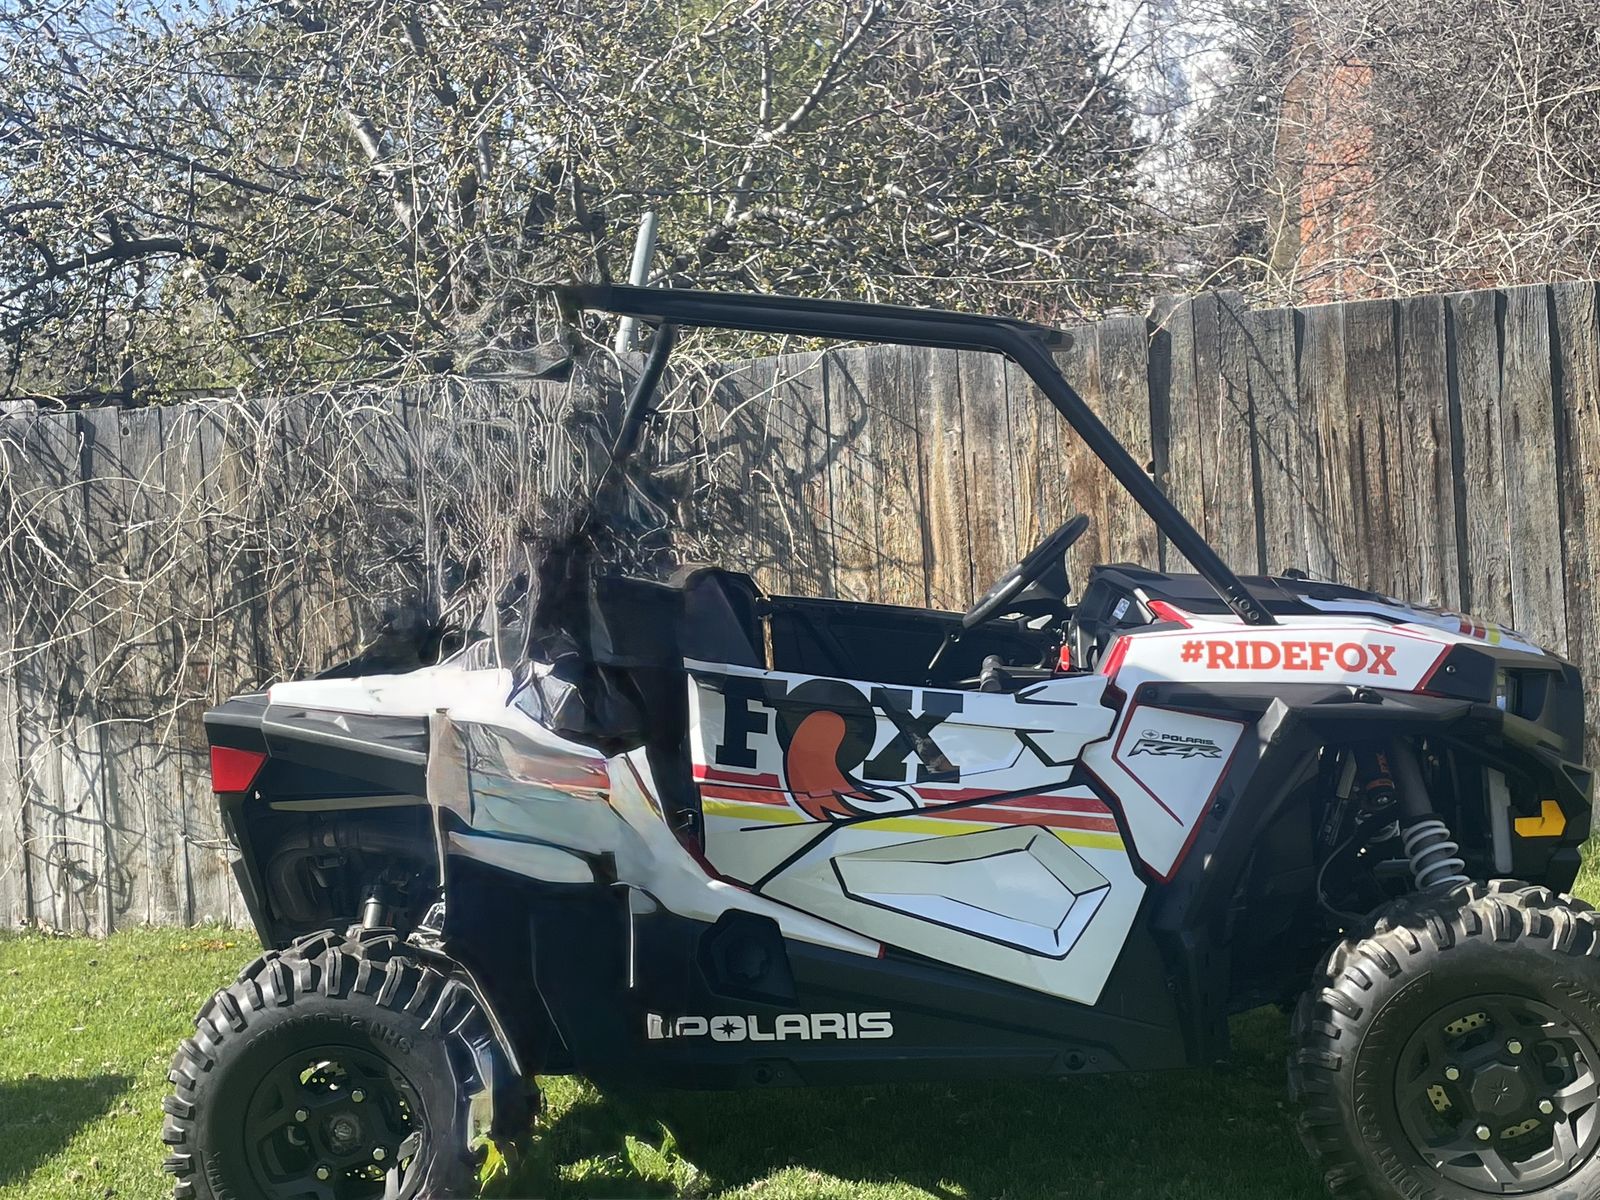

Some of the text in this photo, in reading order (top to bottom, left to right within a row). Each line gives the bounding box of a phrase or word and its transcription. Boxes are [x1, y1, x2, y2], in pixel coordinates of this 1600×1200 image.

[1180, 640, 1397, 676] #RIDEFOX
[716, 679, 964, 818] FOX
[1127, 738, 1223, 759] RZR
[1161, 733, 1215, 746] POLARIS
